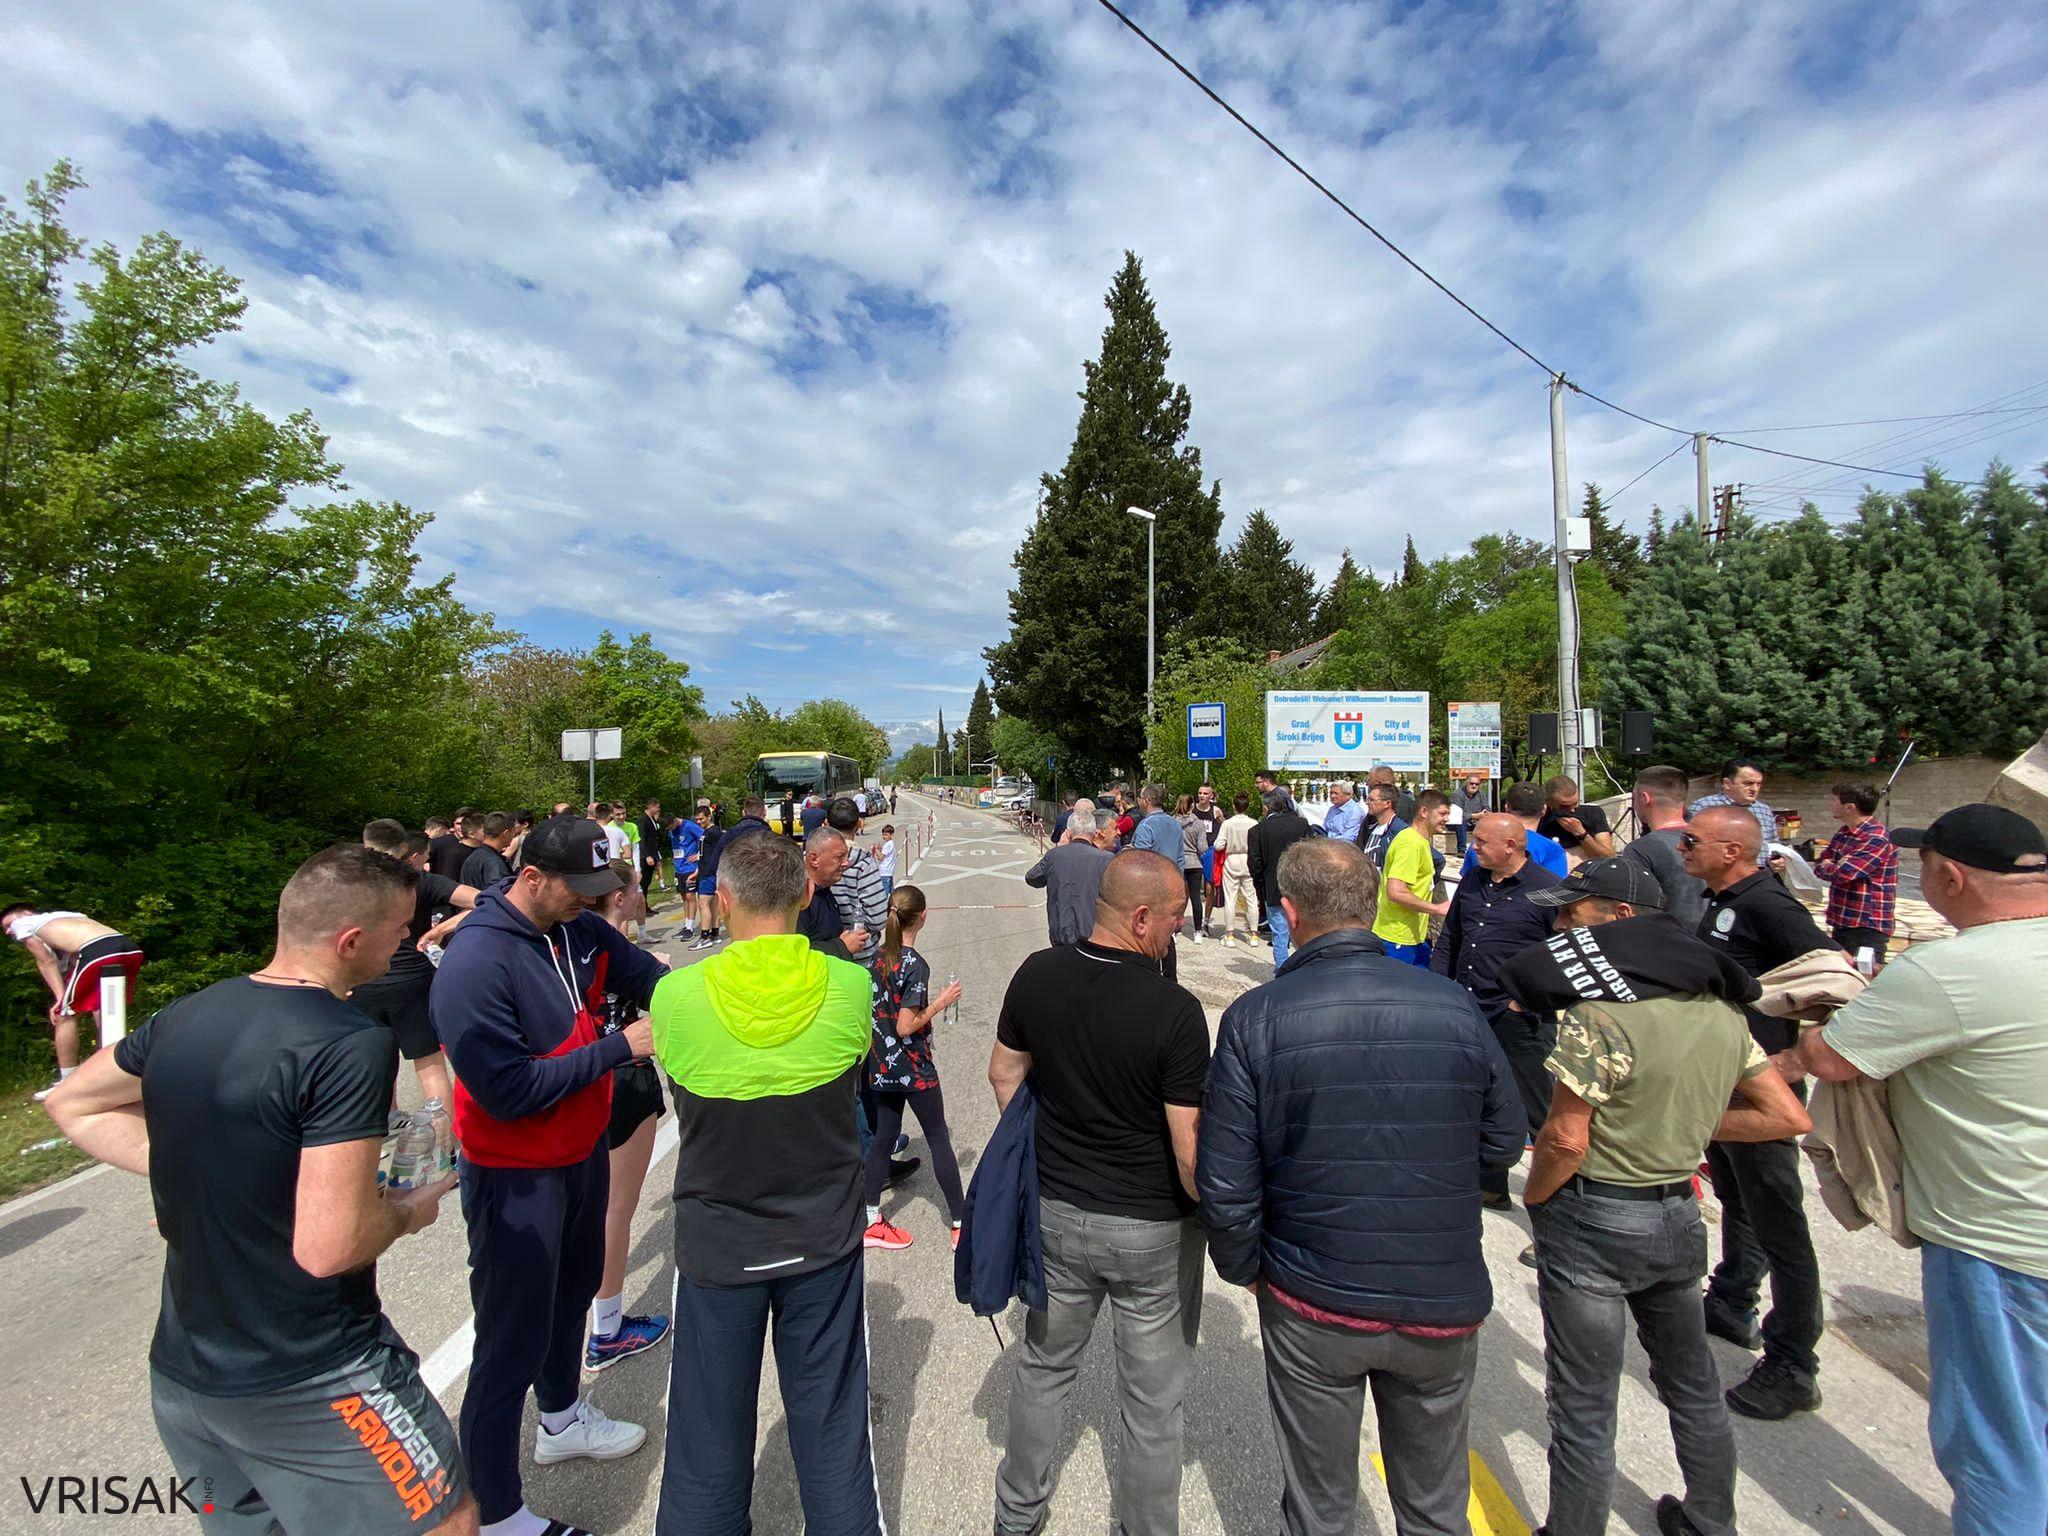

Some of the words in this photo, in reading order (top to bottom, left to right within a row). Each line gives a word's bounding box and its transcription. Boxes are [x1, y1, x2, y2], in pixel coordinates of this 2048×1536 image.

[1291, 719, 1310, 729] Grad
[1384, 719, 1400, 731] City
[1401, 719, 1410, 729] of
[1301, 732, 1326, 743] Brijeg
[1398, 732, 1422, 744] Brijeg
[361, 1382, 441, 1479] UNDER
[330, 1395, 433, 1522] ARMOUR
